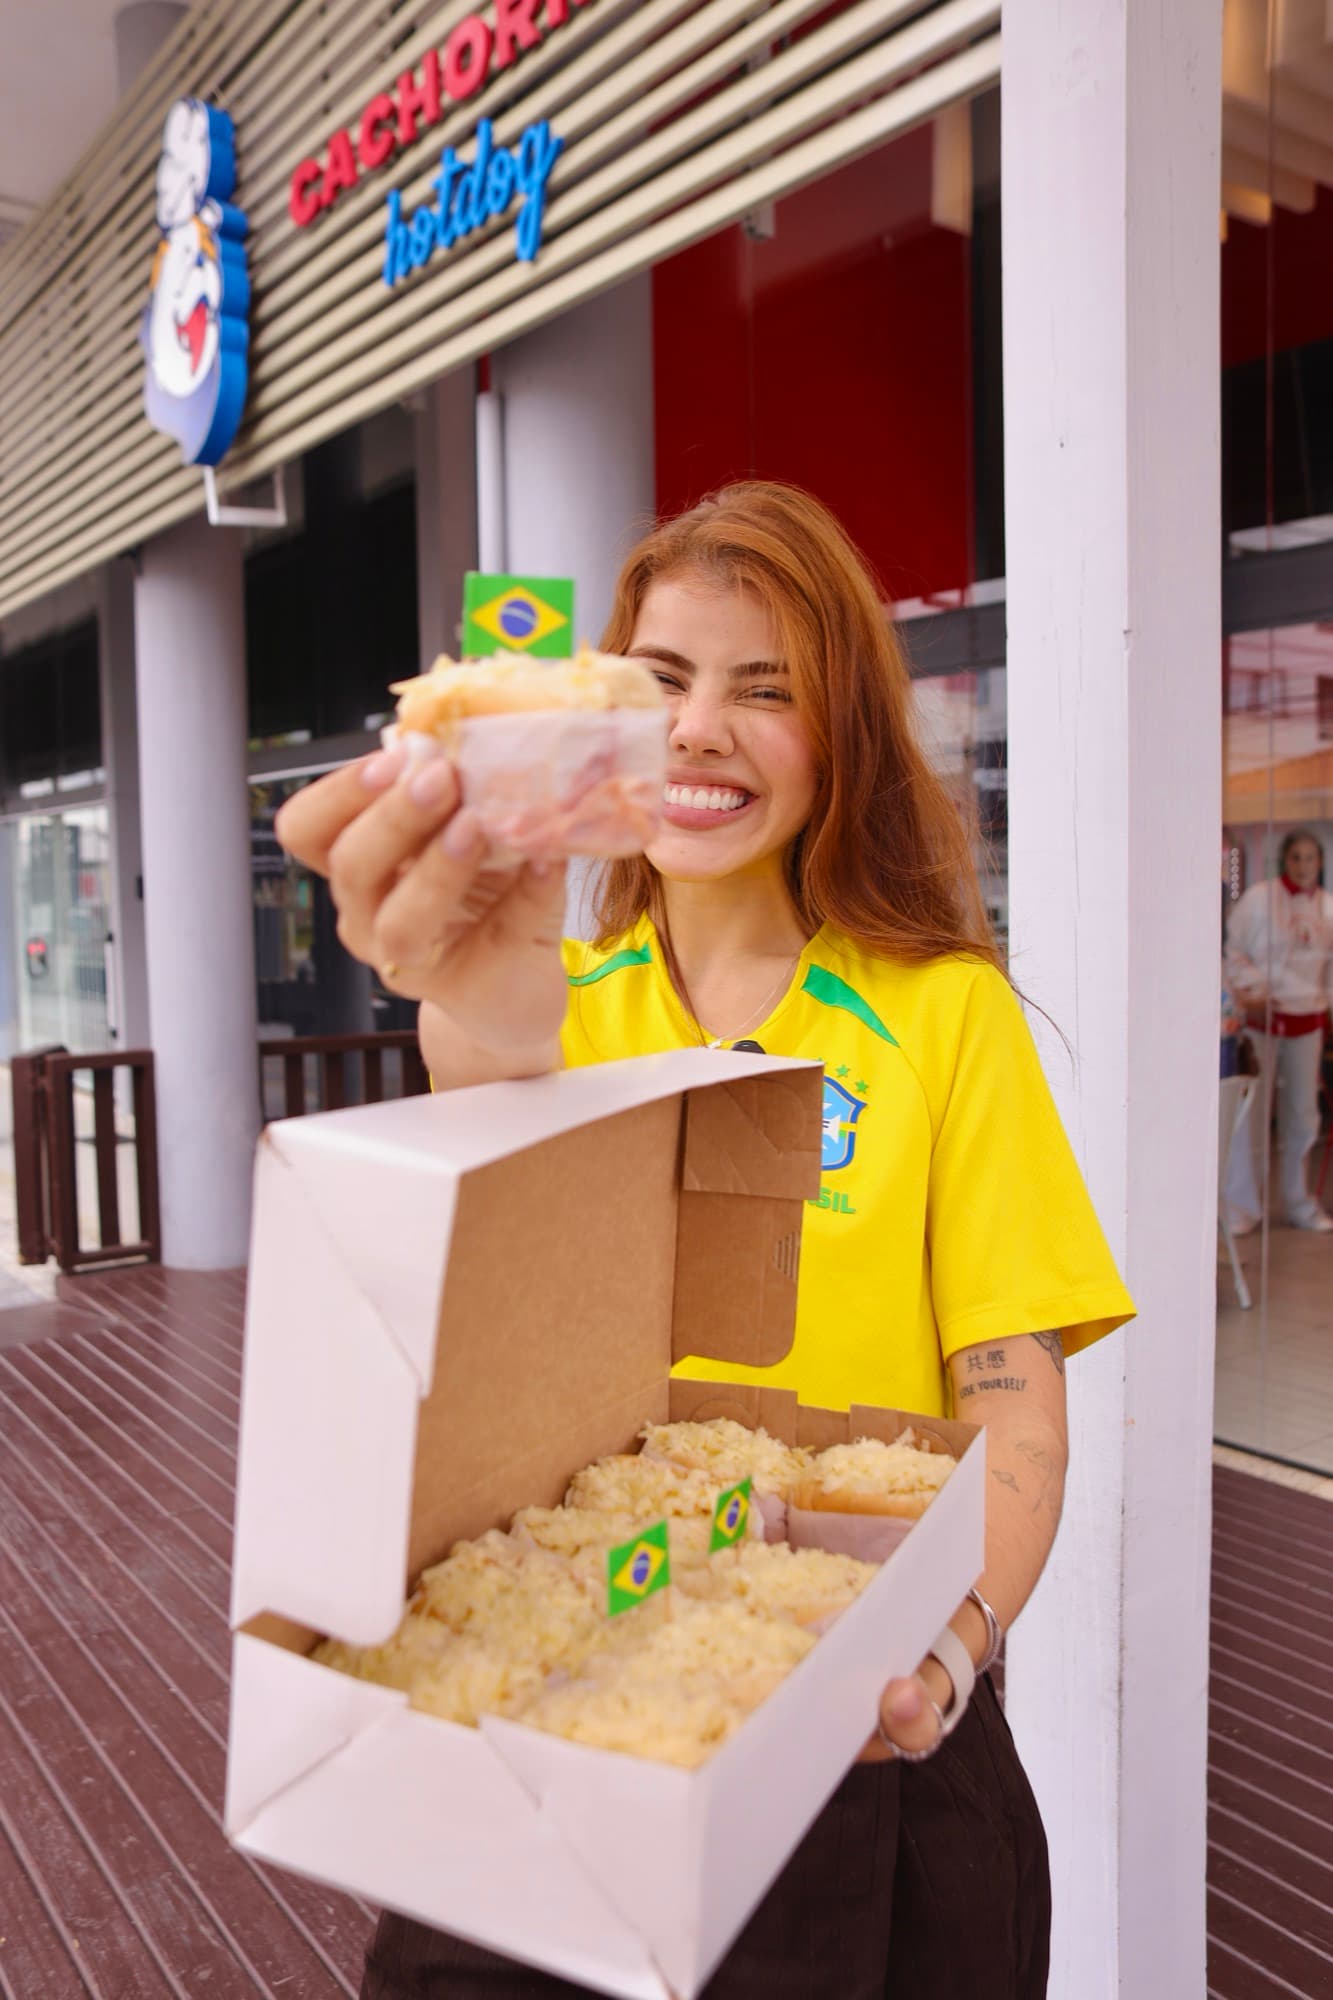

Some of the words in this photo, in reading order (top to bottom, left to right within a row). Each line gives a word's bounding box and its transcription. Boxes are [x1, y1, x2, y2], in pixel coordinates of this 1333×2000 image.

[381, 117, 565, 287] hotdog
[808, 1187, 856, 1214] SIL
[977, 1377, 1027, 1392] YOURSELF
